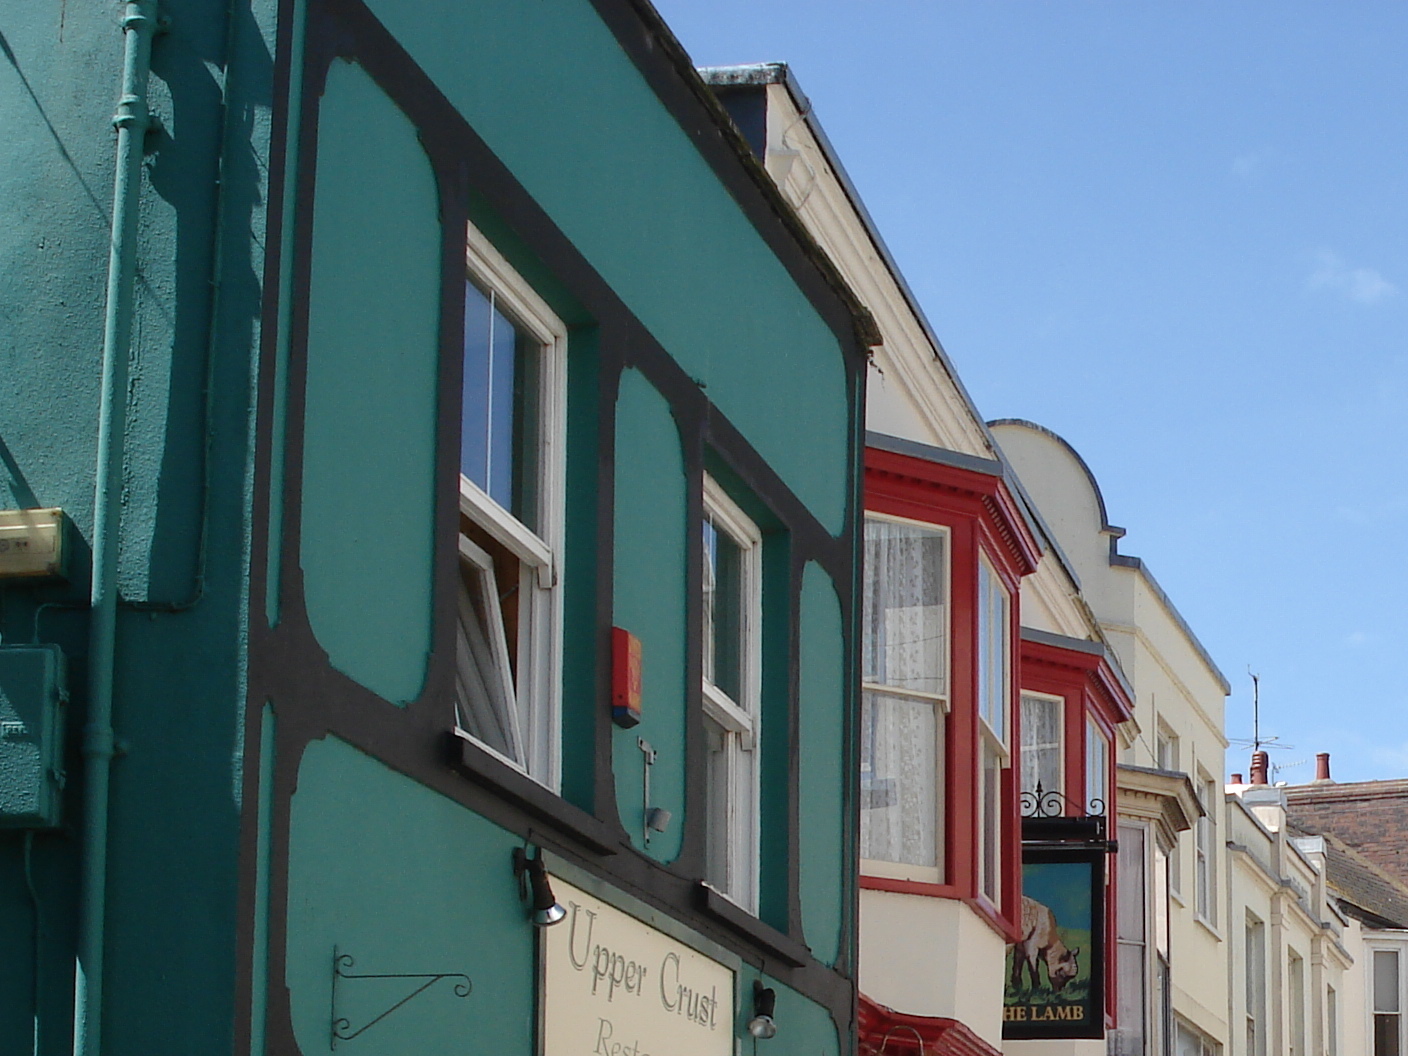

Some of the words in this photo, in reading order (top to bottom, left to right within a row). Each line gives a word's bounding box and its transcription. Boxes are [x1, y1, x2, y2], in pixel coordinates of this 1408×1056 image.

[568, 900, 647, 1002] Upper
[659, 951, 719, 1031] Crust
[1002, 1005, 1027, 1021] HE
[1031, 1004, 1084, 1021] LAMB
